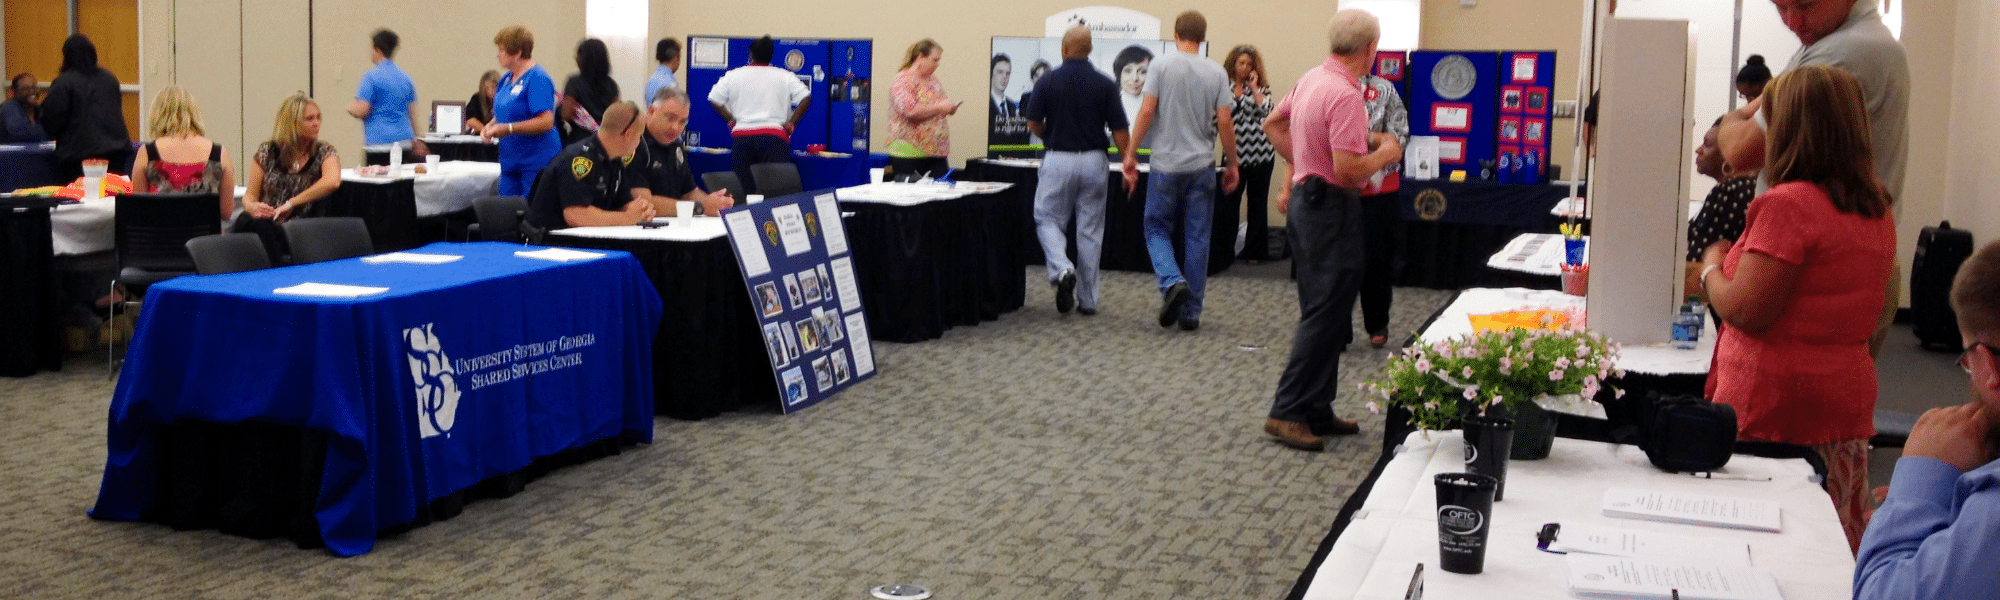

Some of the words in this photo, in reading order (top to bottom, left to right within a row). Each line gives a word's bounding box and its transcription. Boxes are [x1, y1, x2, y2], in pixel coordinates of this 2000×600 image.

[1087, 21, 1137, 32] Ambassador
[455, 349, 513, 375] UNIVERSITY
[514, 342, 545, 361] SYSTEM
[559, 332, 596, 351] GEORGIA
[472, 368, 511, 390] SHARED
[512, 359, 549, 379] SERVICES
[550, 352, 583, 371] CENTER
[1449, 510, 1476, 519] OFTC
